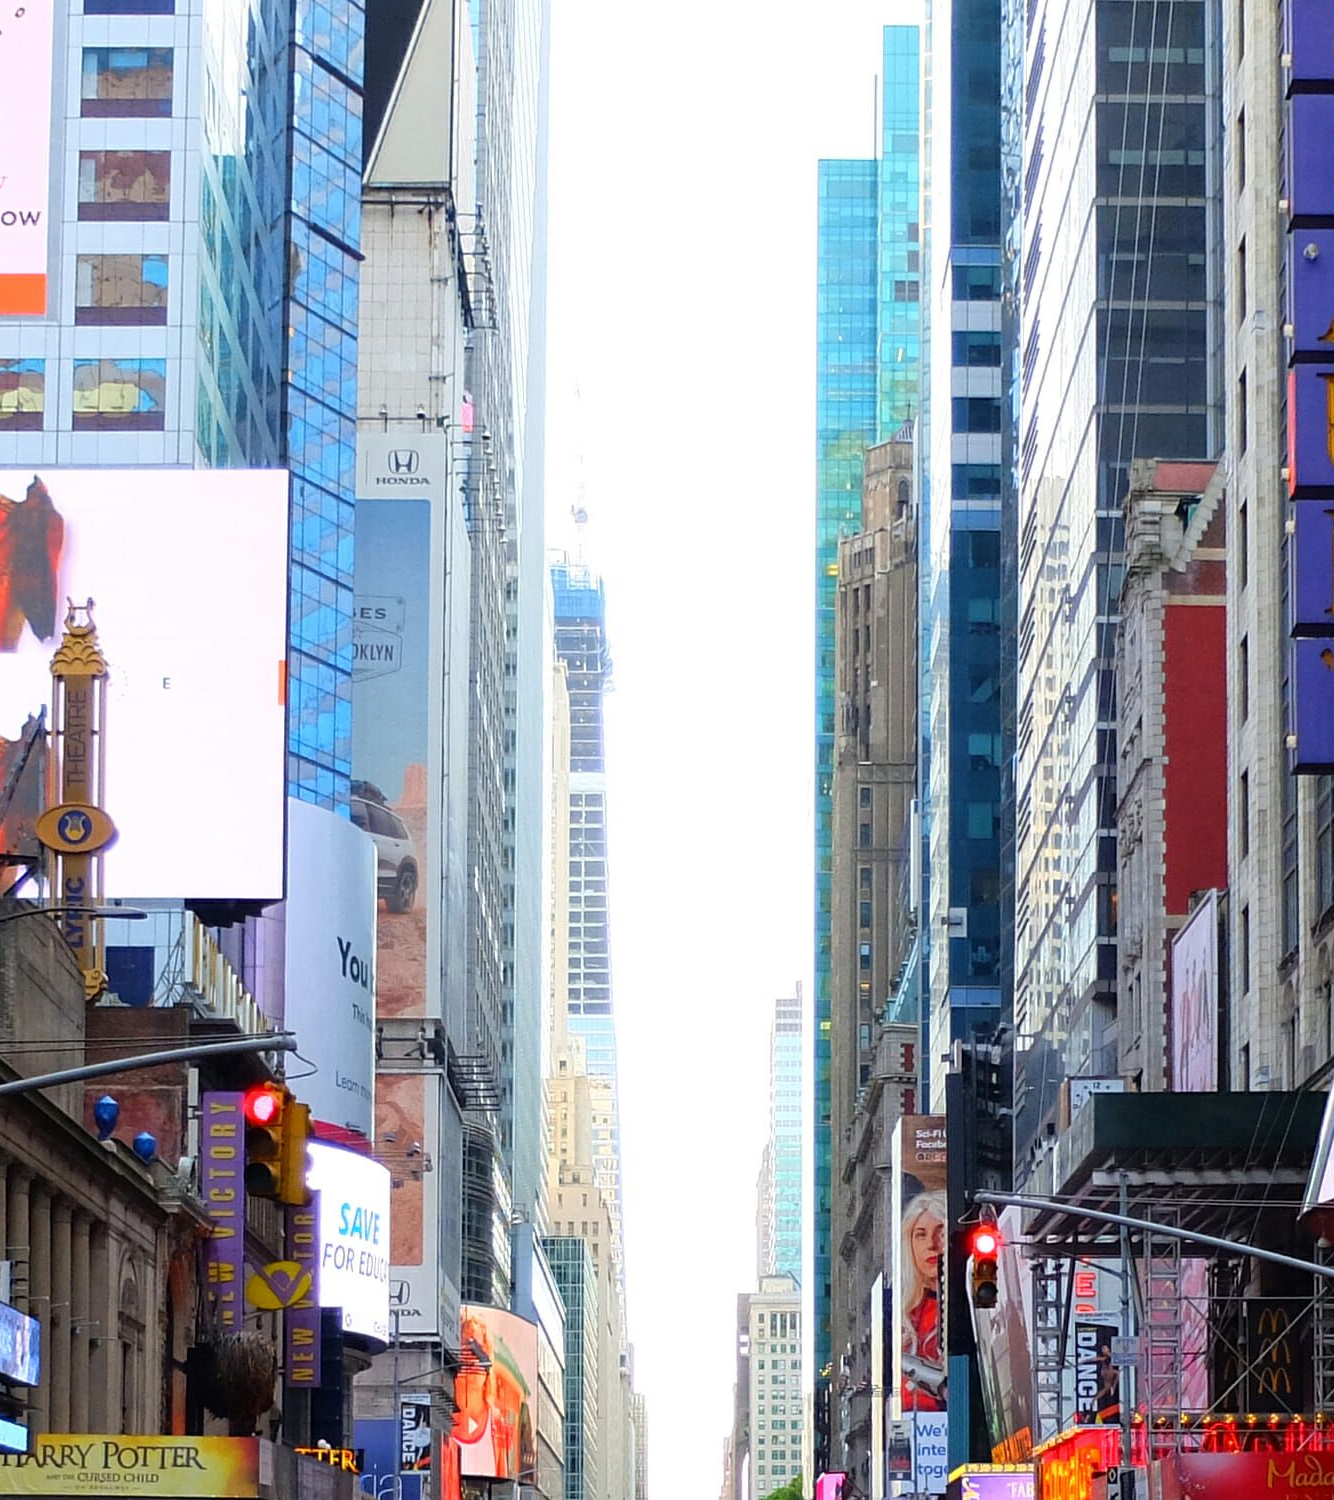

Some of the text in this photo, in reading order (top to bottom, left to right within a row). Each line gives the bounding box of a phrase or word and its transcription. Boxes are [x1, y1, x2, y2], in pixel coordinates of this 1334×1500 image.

[375, 476, 431, 486] HONDA
[67, 690, 88, 788] THEATRE
[337, 936, 369, 990] You
[335, 1069, 360, 1097] Learn
[208, 1100, 237, 1239] VICTORY
[338, 1202, 380, 1246] SAVE
[322, 1242, 355, 1273] FOR
[291, 1327, 315, 1382] NEW
[1077, 1331, 1098, 1413] DANCE
[101, 1440, 208, 1470] POTTER
[401, 1406, 417, 1463] DANCE
[77, 1472, 160, 1484] CURSED CHILD
